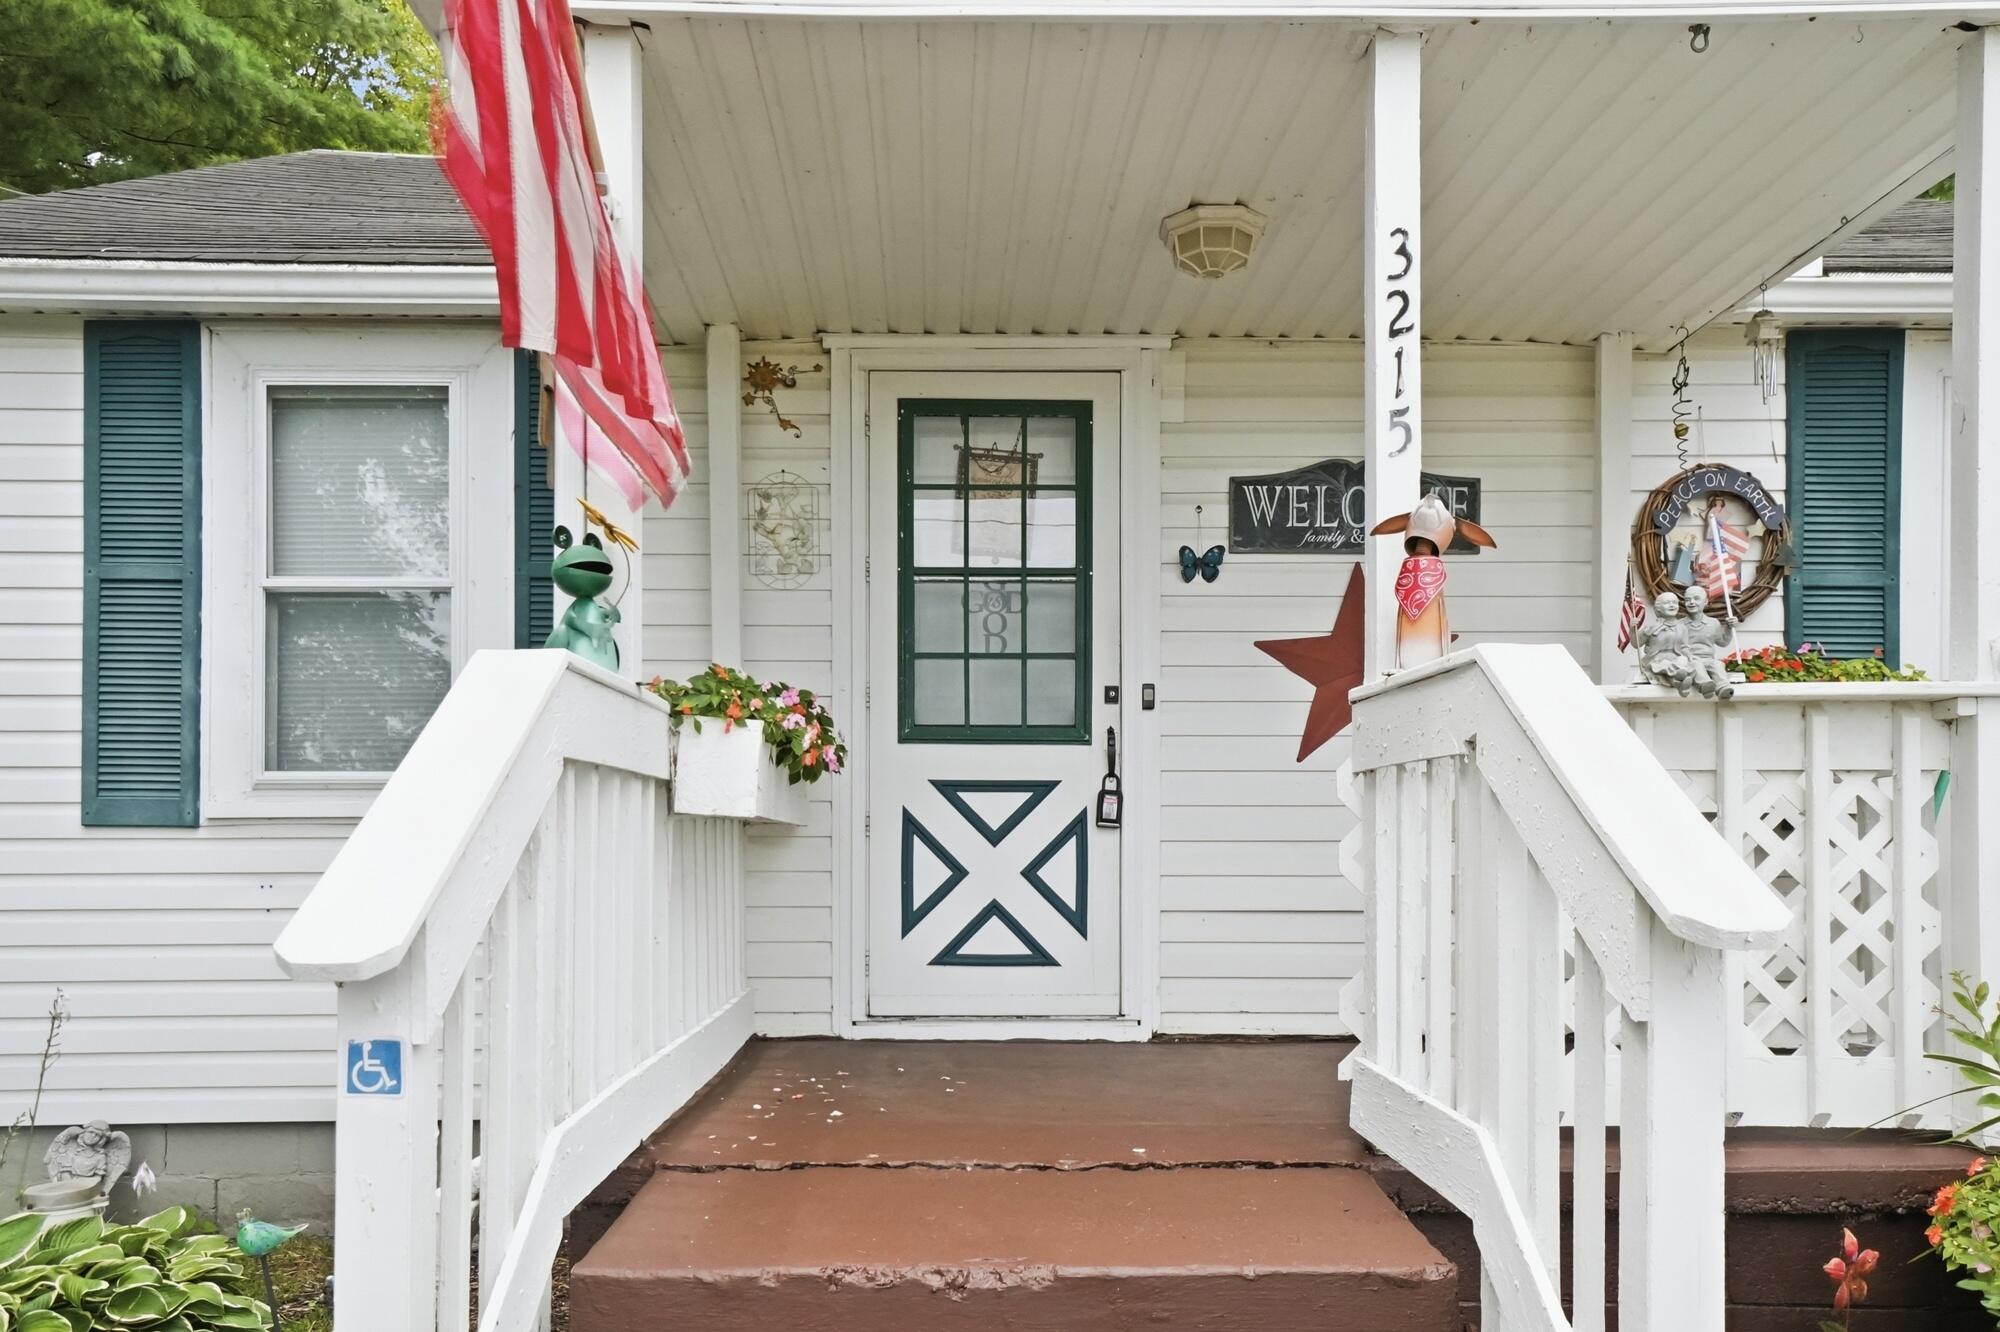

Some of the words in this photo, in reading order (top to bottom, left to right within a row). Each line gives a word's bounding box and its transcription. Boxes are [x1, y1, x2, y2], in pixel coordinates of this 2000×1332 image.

[1387, 227, 1415, 458] 3215
[1241, 485, 1469, 528] WELCE
[1659, 477, 1701, 528] PEACE
[1704, 472, 1728, 488] ON
[1734, 476, 1776, 522] EARTH
[1297, 529, 1346, 549] family
[1350, 528, 1366, 544] &
